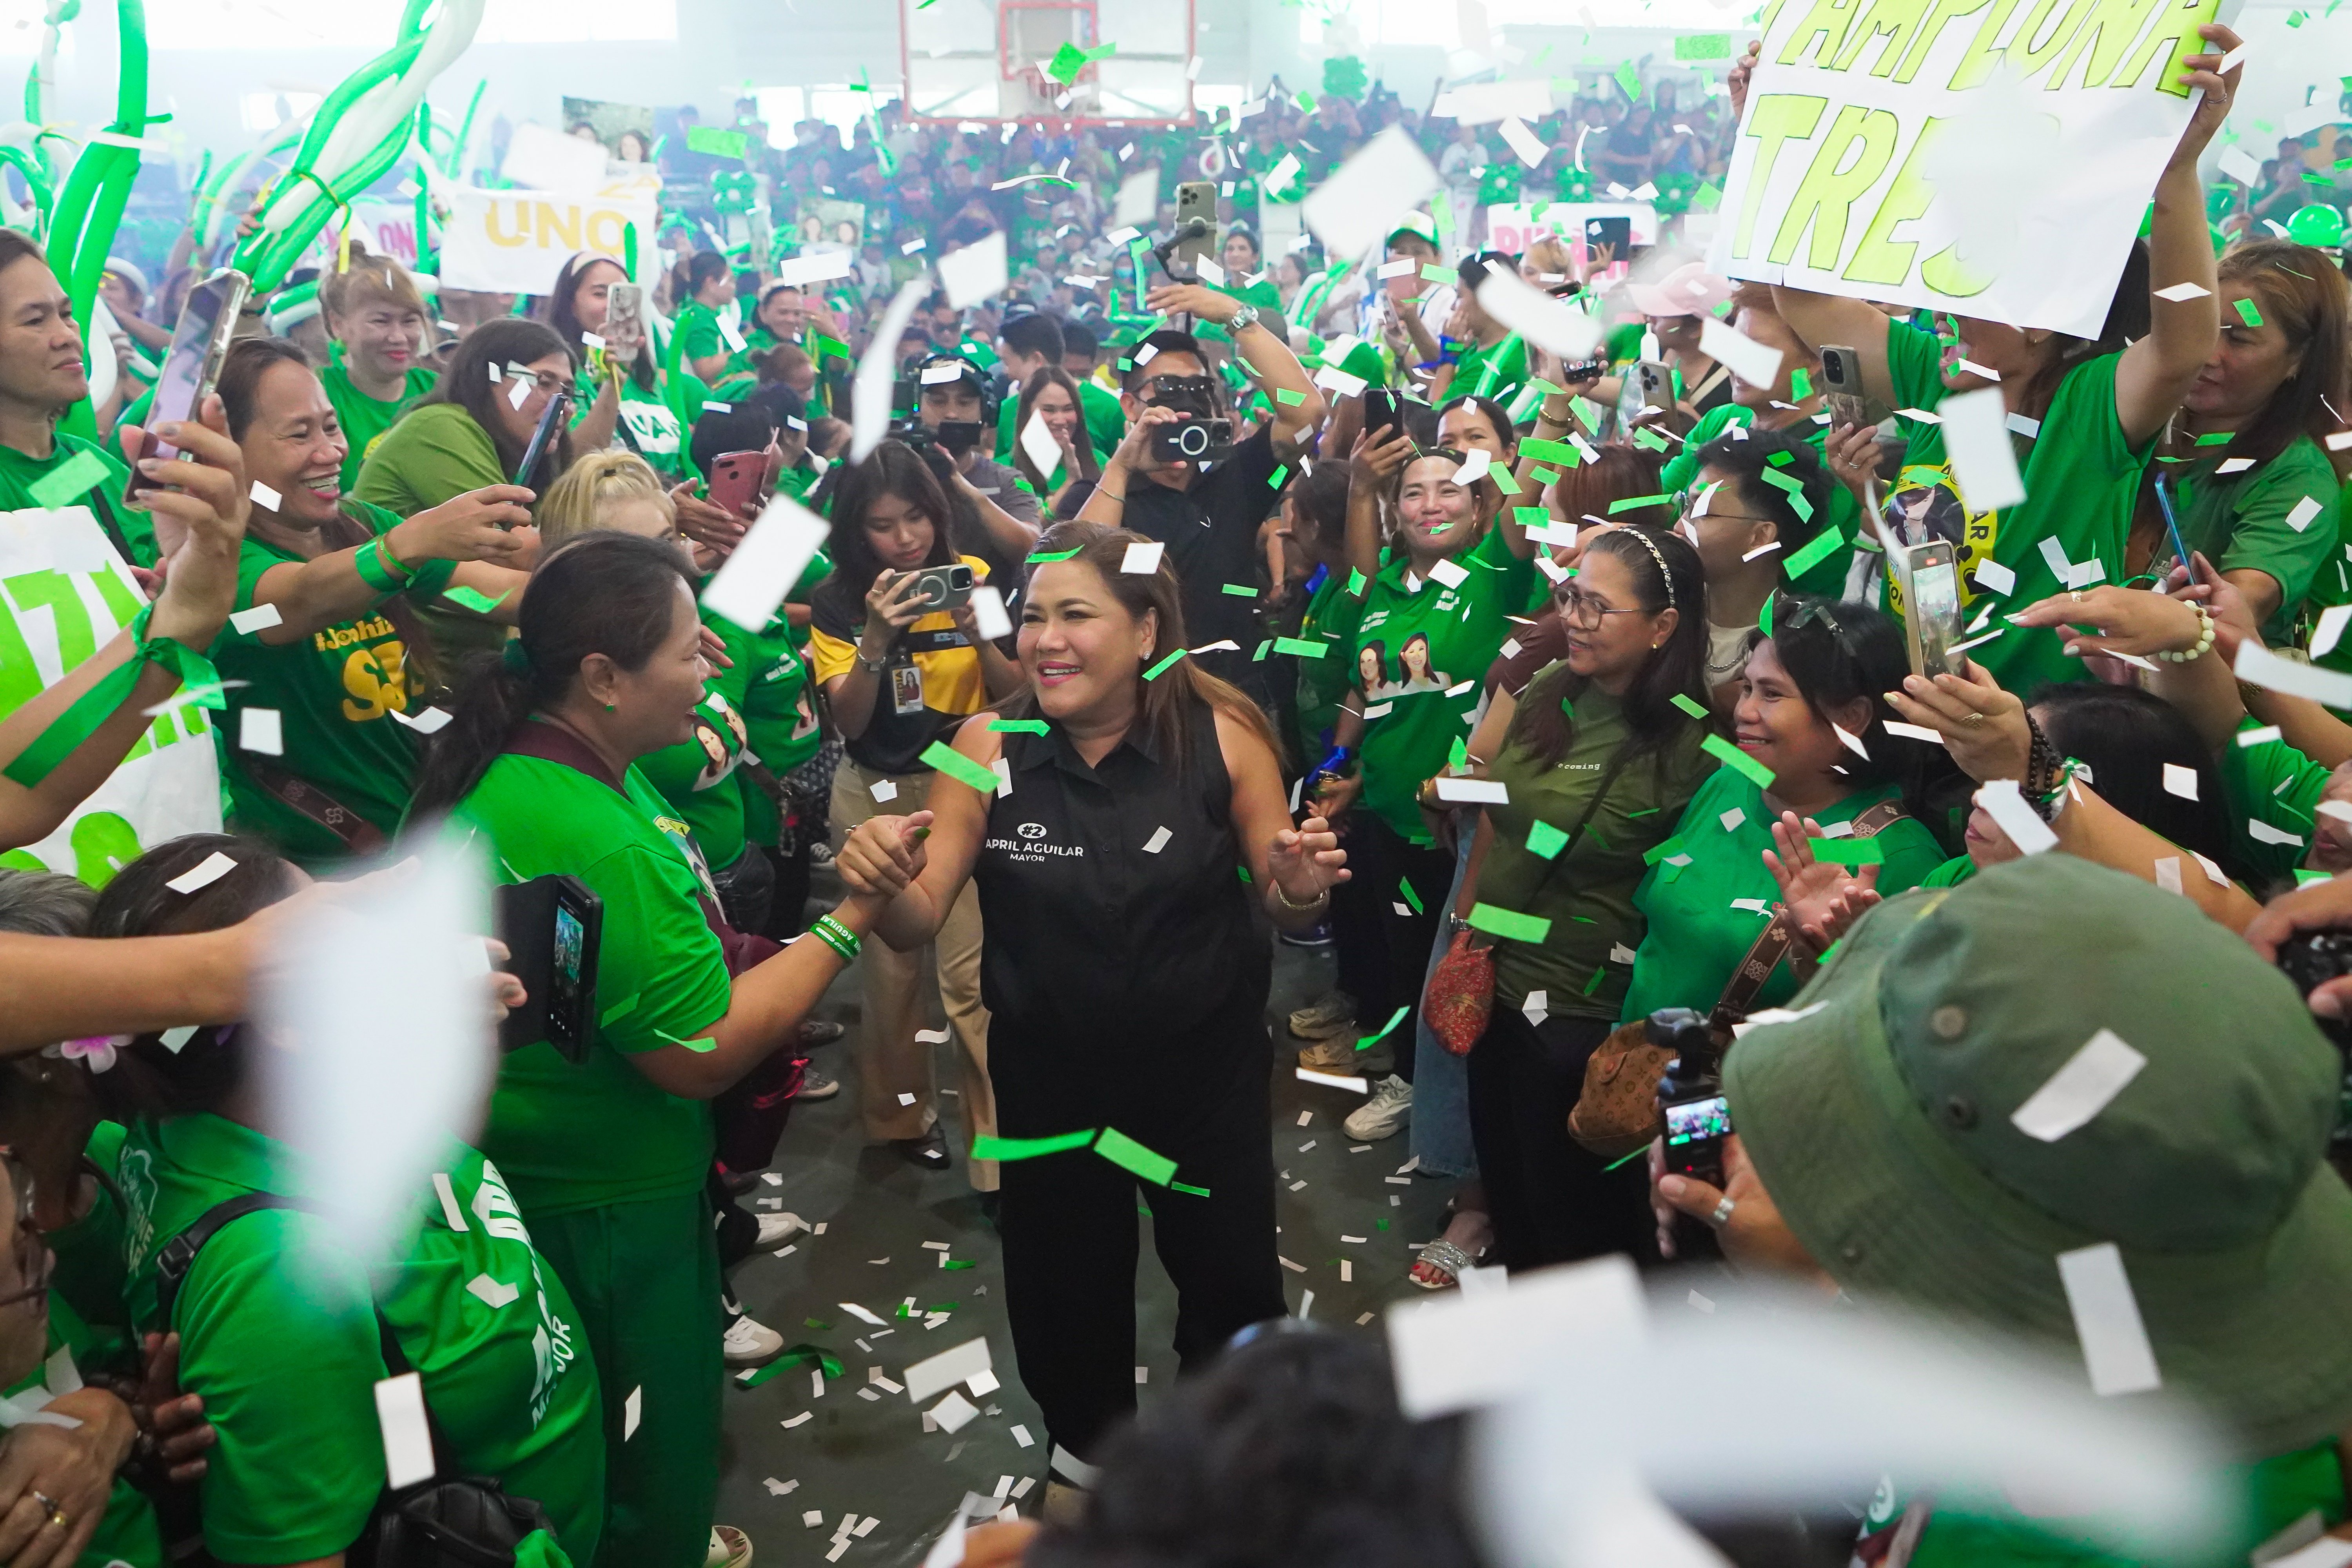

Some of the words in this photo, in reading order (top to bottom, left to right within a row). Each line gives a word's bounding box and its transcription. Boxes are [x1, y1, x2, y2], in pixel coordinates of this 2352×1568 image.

[485, 198, 627, 254] UNO
[1021, 825, 1043, 837] #2
[985, 838, 1020, 851] APRIL
[1023, 842, 1083, 857] AGUILAR
[1010, 853, 1045, 862] MAYOR
